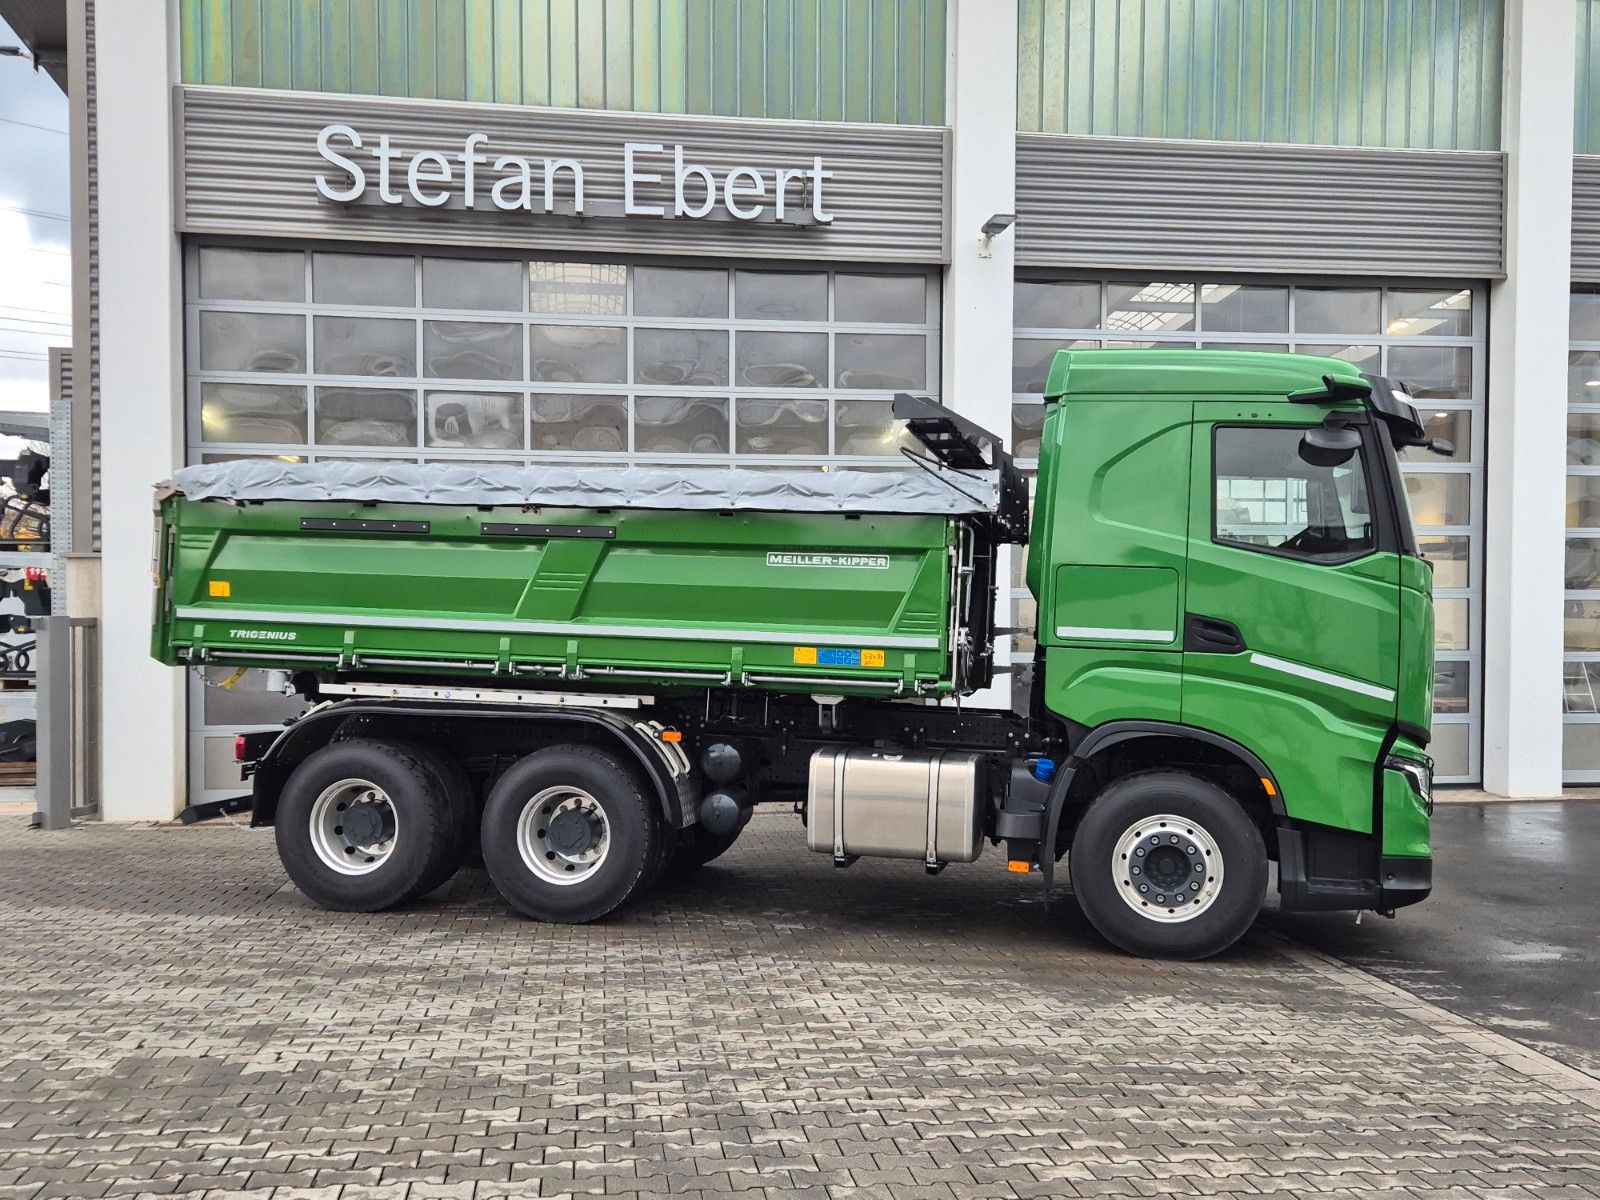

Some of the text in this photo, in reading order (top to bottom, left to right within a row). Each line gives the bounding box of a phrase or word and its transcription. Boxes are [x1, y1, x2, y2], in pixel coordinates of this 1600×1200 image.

[314, 123, 834, 223] Stefan Ebert
[769, 554, 887, 567] MEILLER-KIPPER
[229, 629, 297, 640] TRIGENIUS
